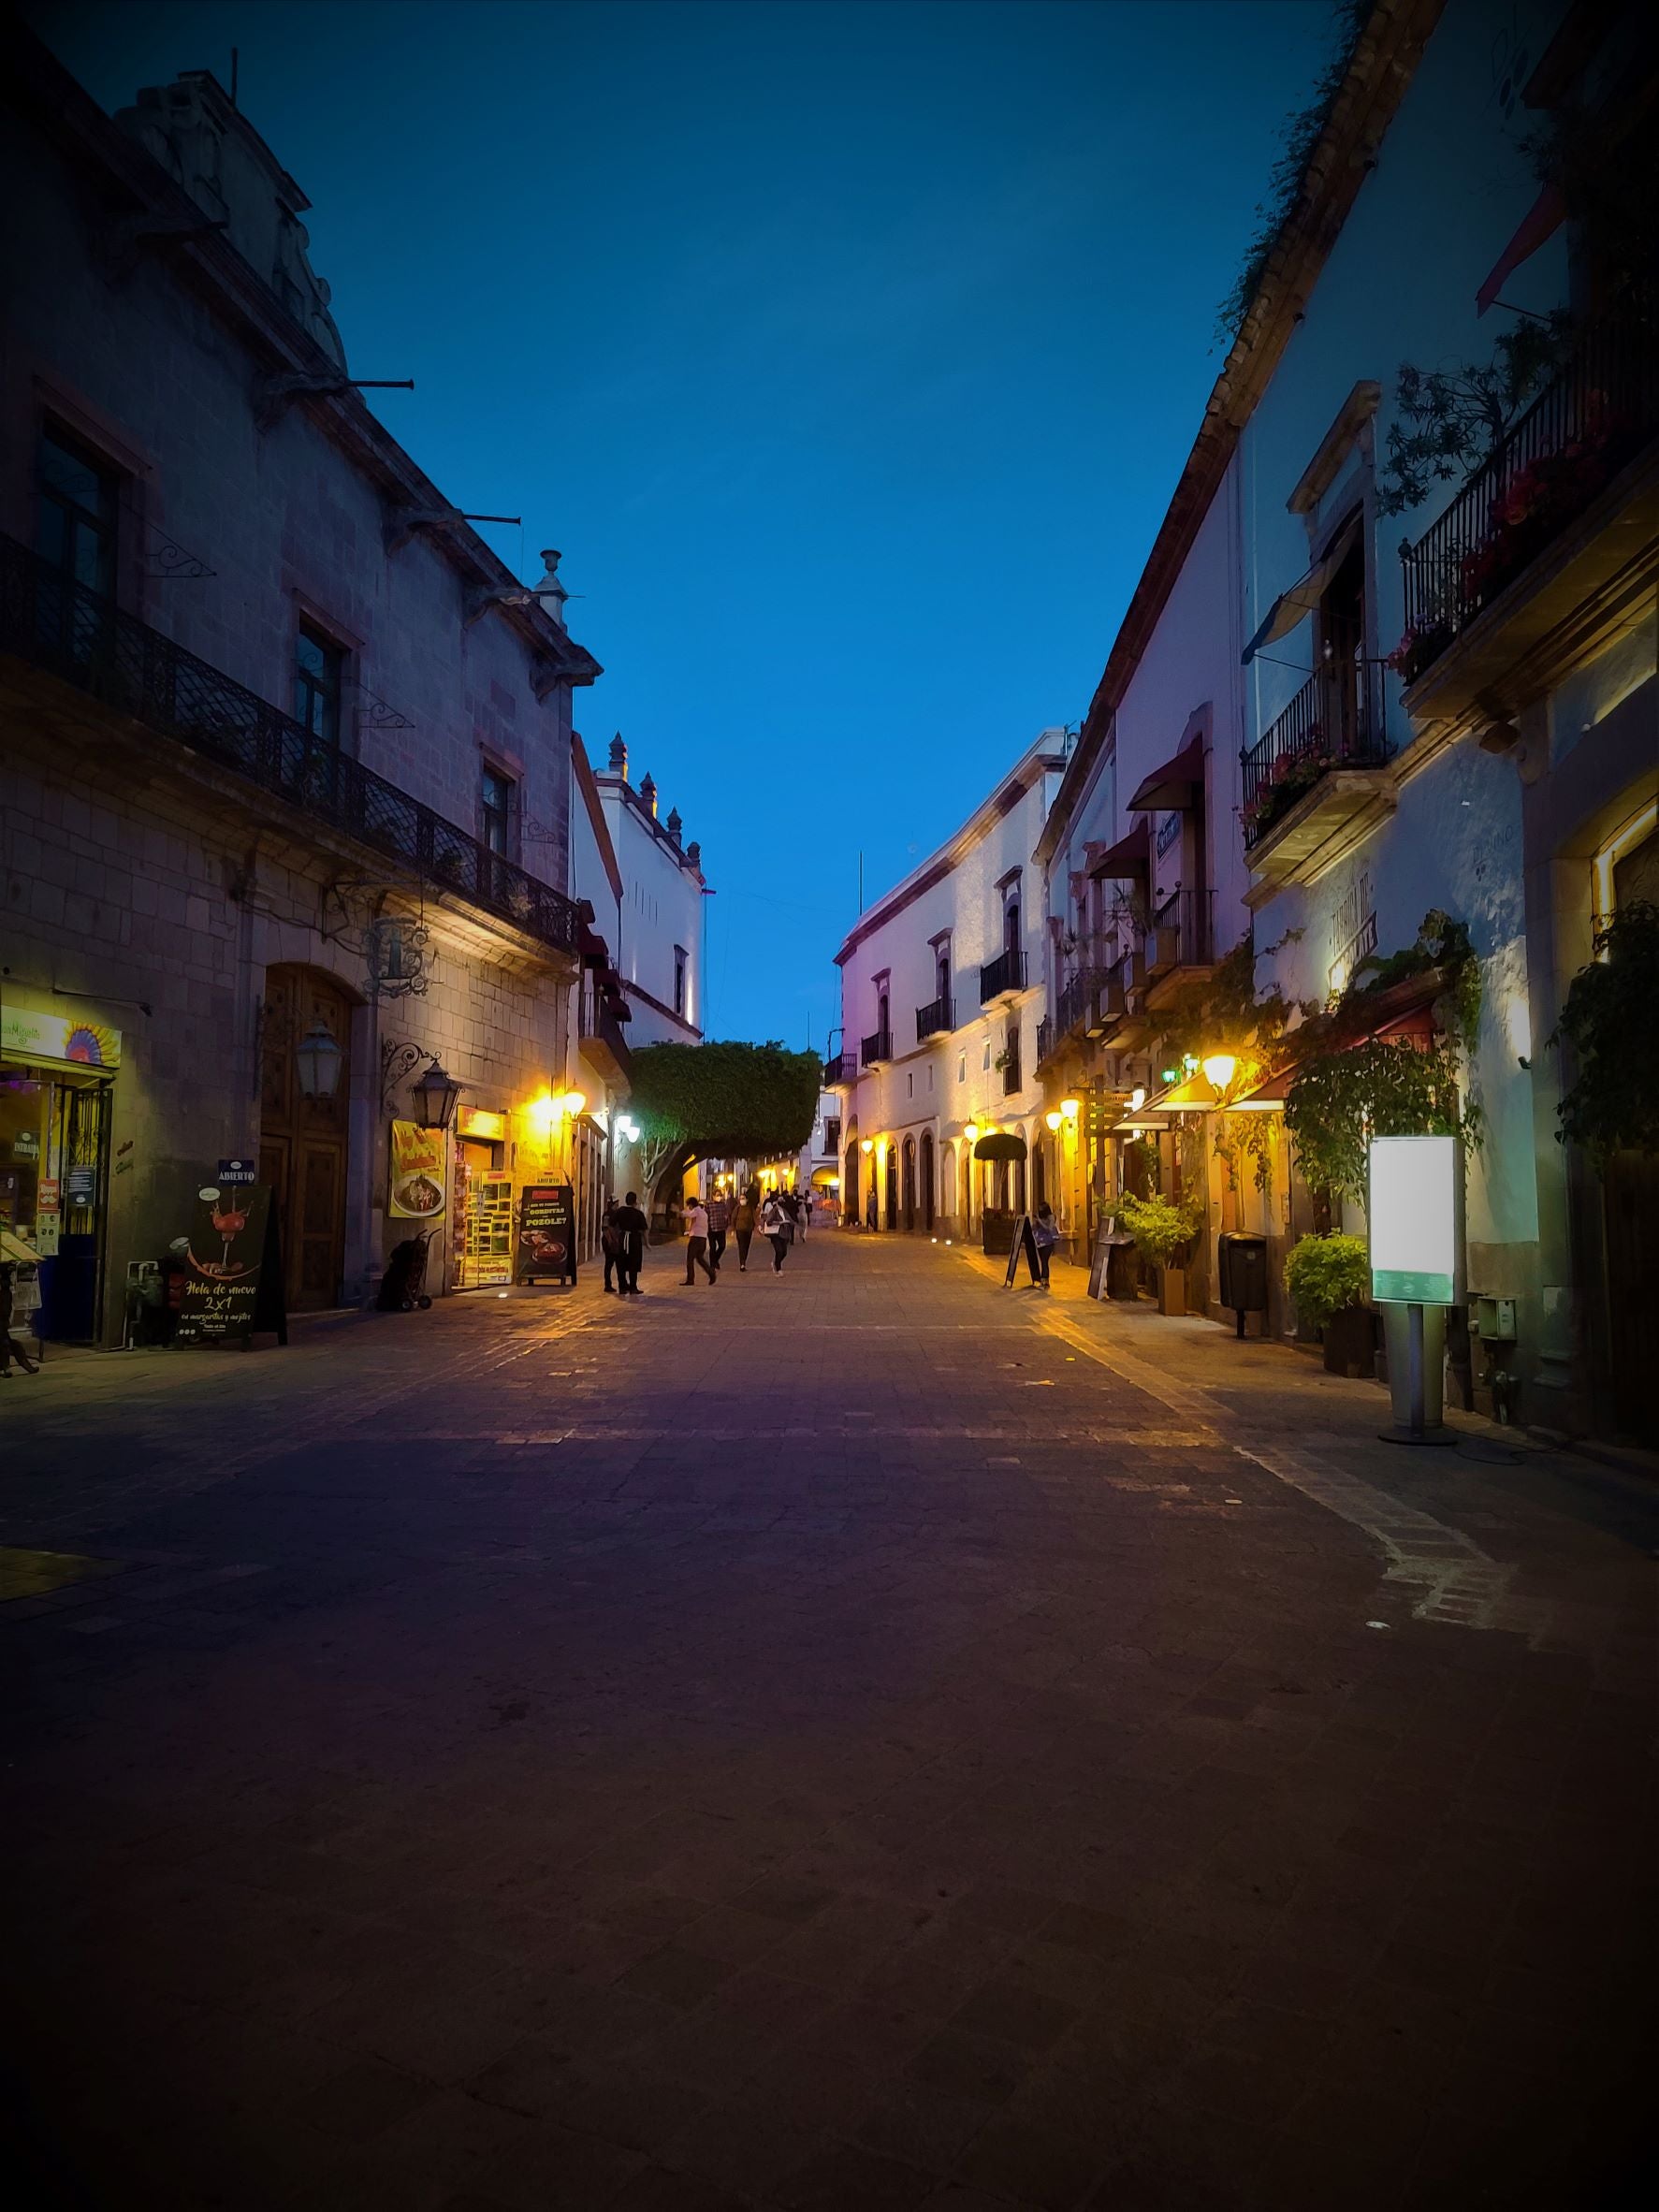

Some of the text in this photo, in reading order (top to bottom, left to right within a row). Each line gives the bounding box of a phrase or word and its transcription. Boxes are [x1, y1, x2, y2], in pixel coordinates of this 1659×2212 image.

[219, 1171, 255, 1181] ABIERTO
[184, 1280, 256, 1295] Hola de nuevo
[203, 1296, 232, 1311] 2x1
